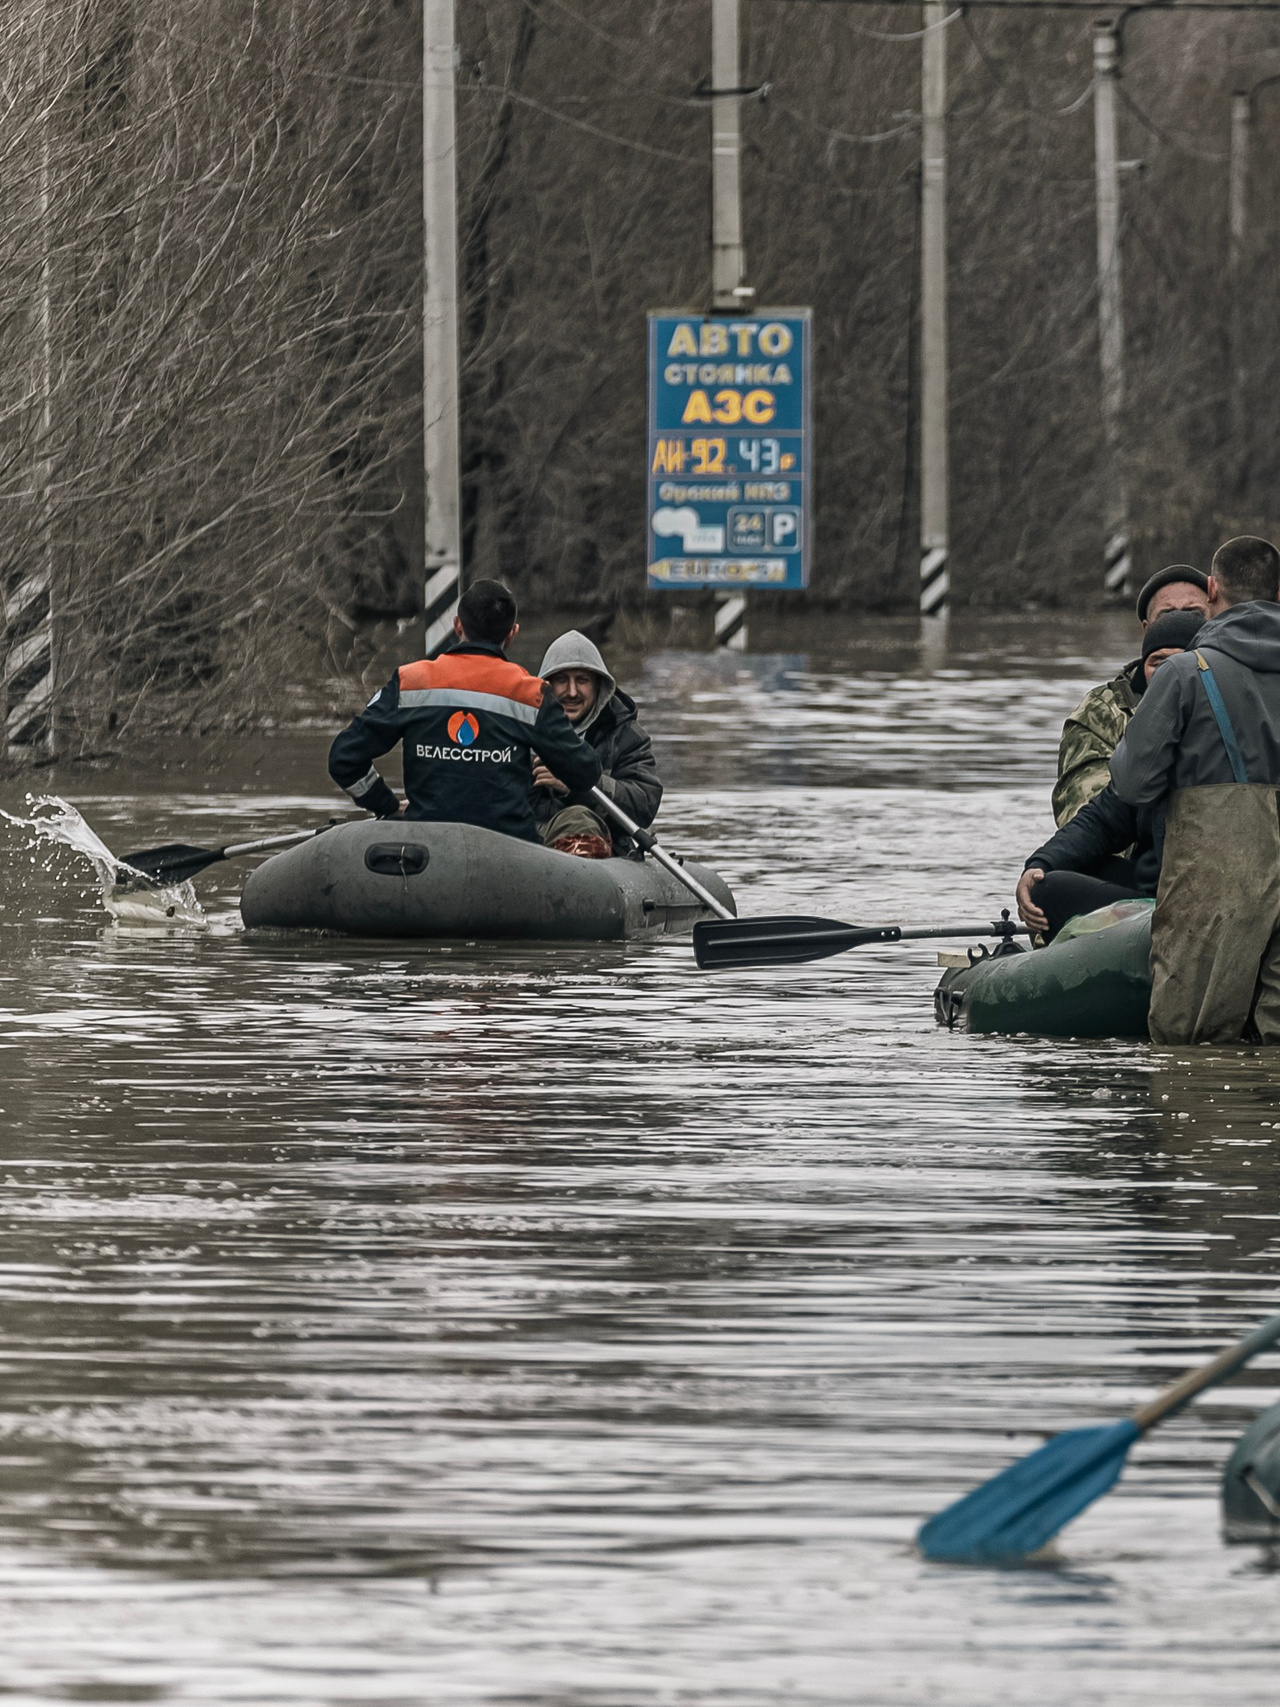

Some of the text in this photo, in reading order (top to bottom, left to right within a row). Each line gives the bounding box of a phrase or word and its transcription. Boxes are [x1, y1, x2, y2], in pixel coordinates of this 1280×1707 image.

[668, 323, 793, 357] АВТО
[664, 363, 793, 385] СТОЯНКА
[682, 389, 775, 424] АЗС
[735, 513, 761, 532] 24
[417, 744, 511, 762] ВЕЛЕССТРОЙ
